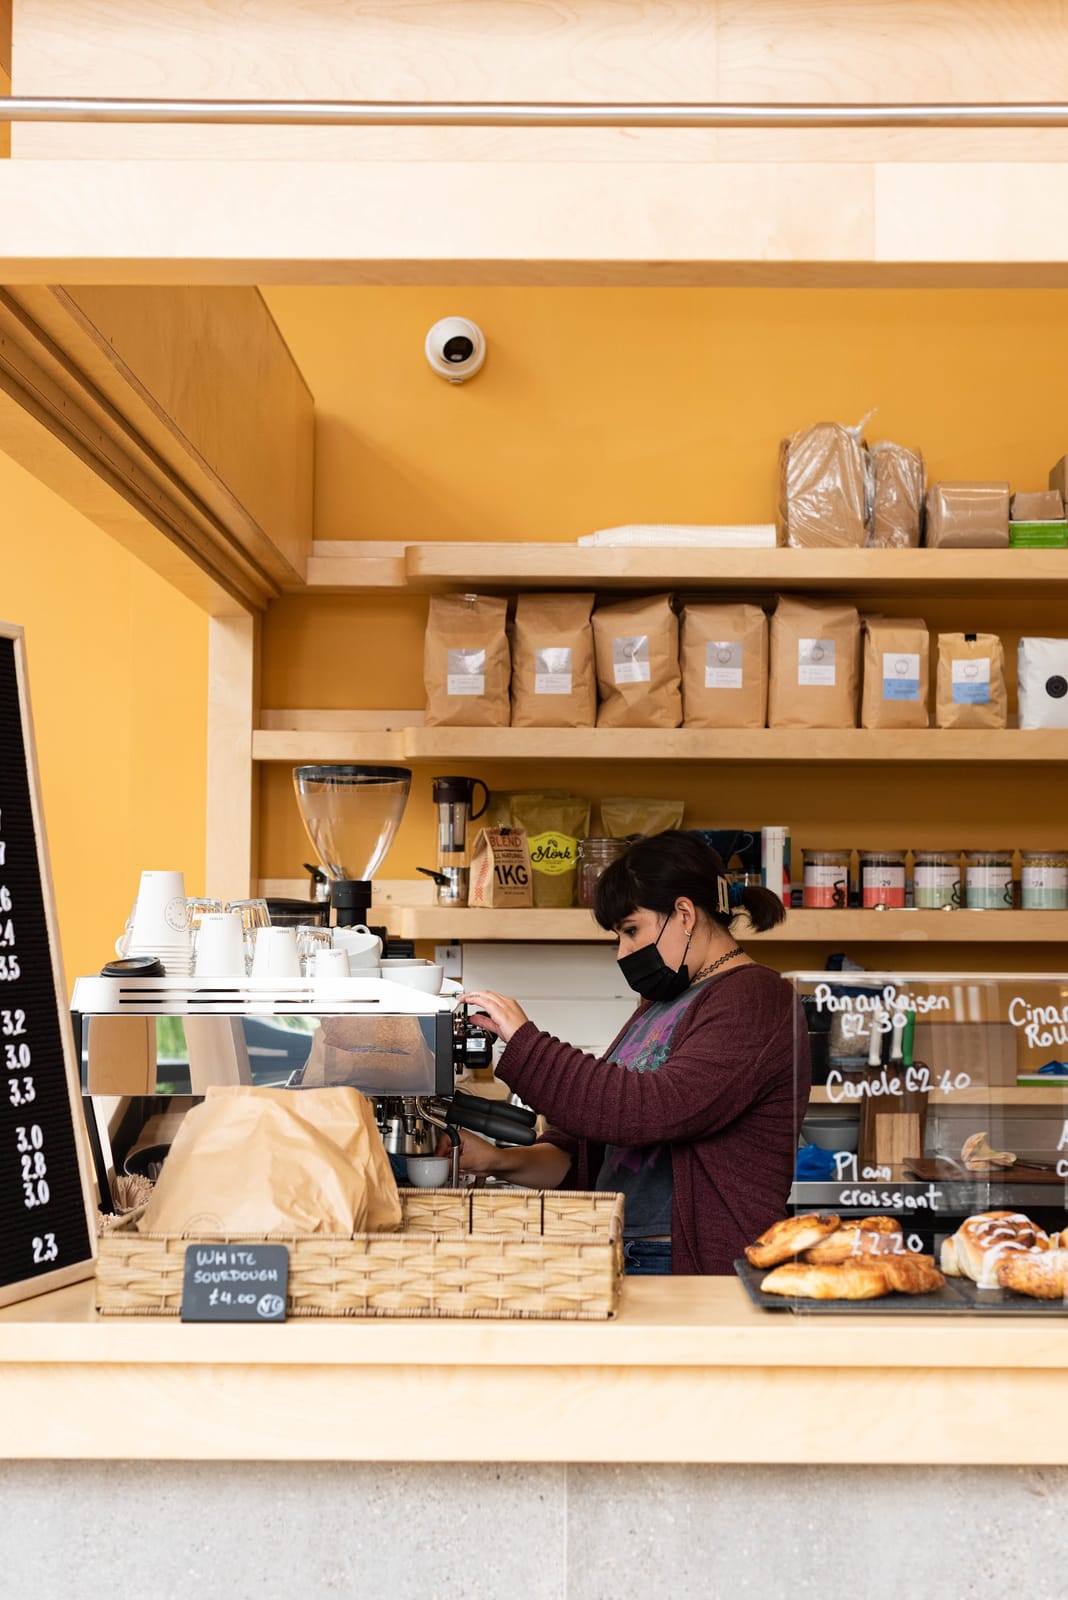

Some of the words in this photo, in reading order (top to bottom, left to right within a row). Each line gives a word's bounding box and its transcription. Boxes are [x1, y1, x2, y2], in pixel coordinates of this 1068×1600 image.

[490, 836, 521, 847] BLEND
[494, 864, 528, 885] 1KG
[1, 1009, 27, 1036] 3.2
[5, 1043, 31, 1069] 3.0
[8, 1077, 36, 1106] 3.3
[16, 1125, 43, 1152] 3.0
[21, 1152, 47, 1180] 2.8
[833, 1151, 891, 1182] Plain
[23, 1180, 49, 1208] 3.0
[839, 1184, 943, 1211] croissant
[32, 1233, 58, 1263] 2.3
[850, 1228, 924, 1256] £2.20
[196, 1250, 256, 1266] WHITE
[193, 1269, 278, 1283] SOURDOUGH
[208, 1288, 256, 1306] £4.00
